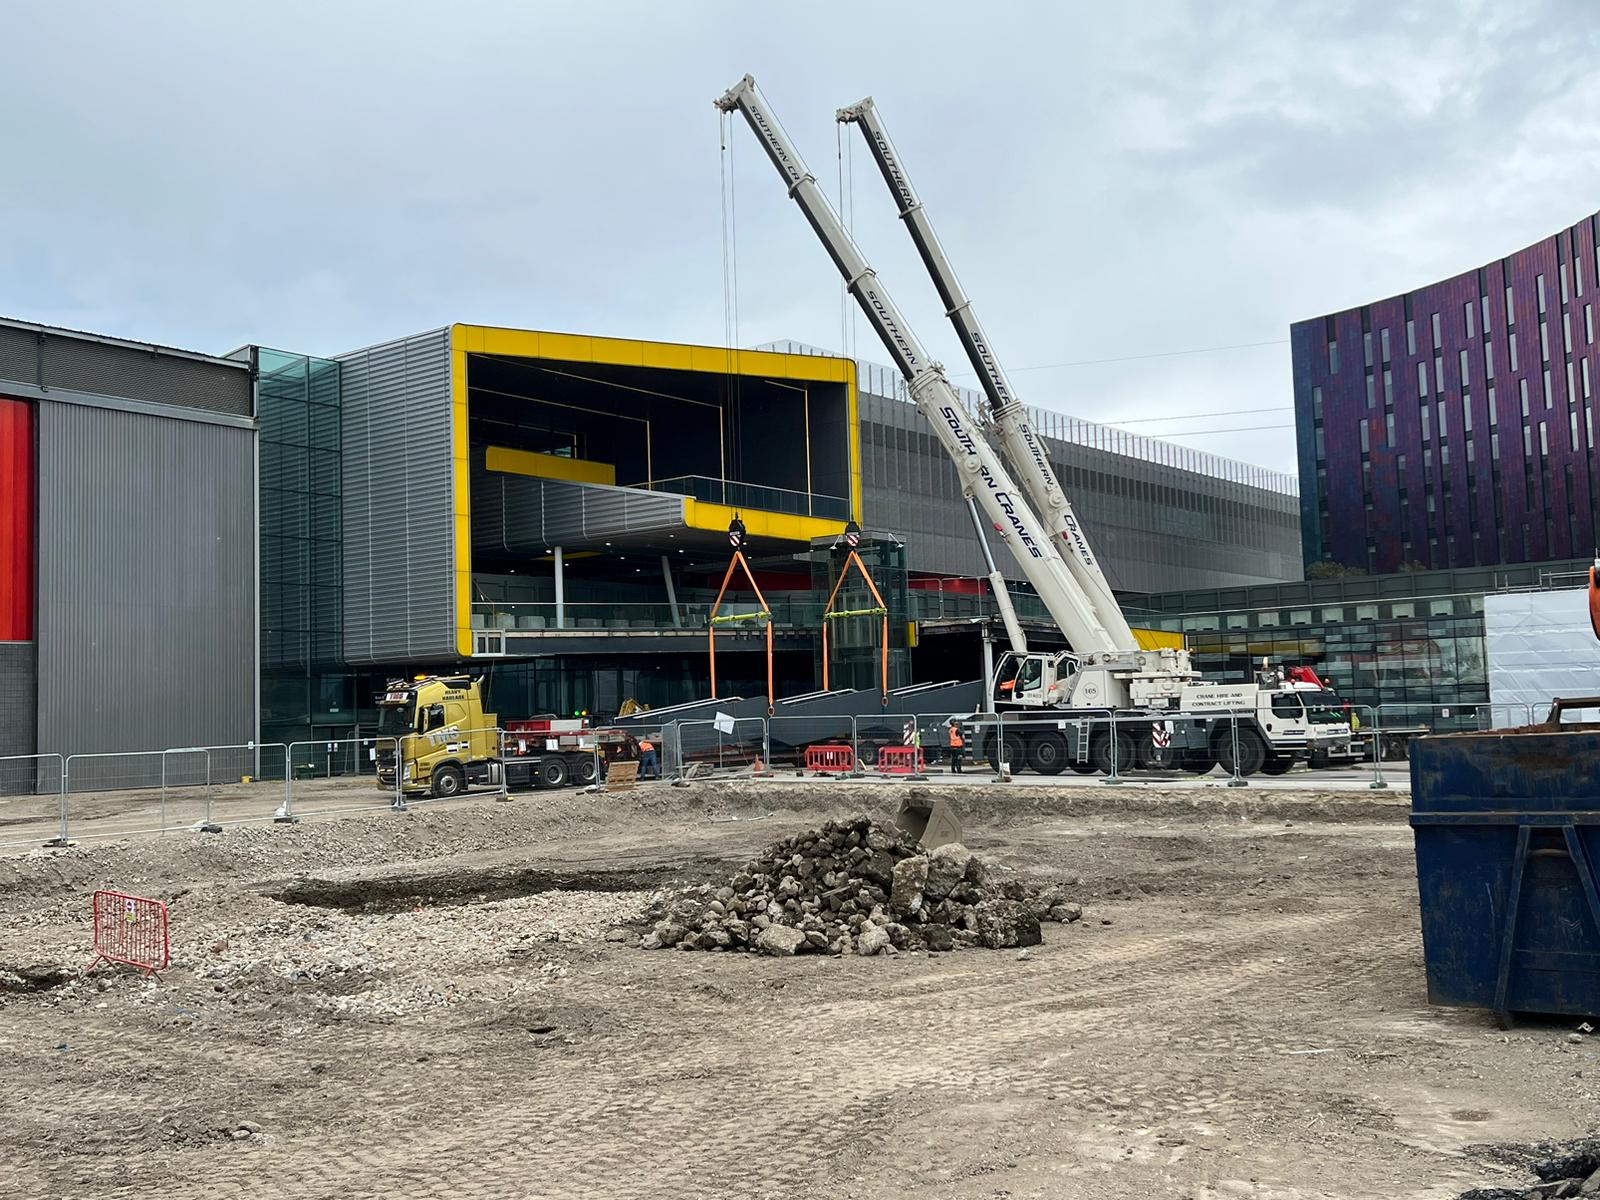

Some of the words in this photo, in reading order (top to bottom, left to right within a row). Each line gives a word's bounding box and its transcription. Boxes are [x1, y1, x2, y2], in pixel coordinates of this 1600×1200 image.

[750, 105, 788, 163] SOUTHERN
[873, 131, 915, 208] SOUTHERN
[866, 290, 918, 365] SOUTHERN
[939, 407, 998, 489] SOUTHRN
[995, 492, 1043, 558] CRANES
[1018, 424, 1054, 486] SOUTHERN
[1063, 514, 1094, 566] CRANES
